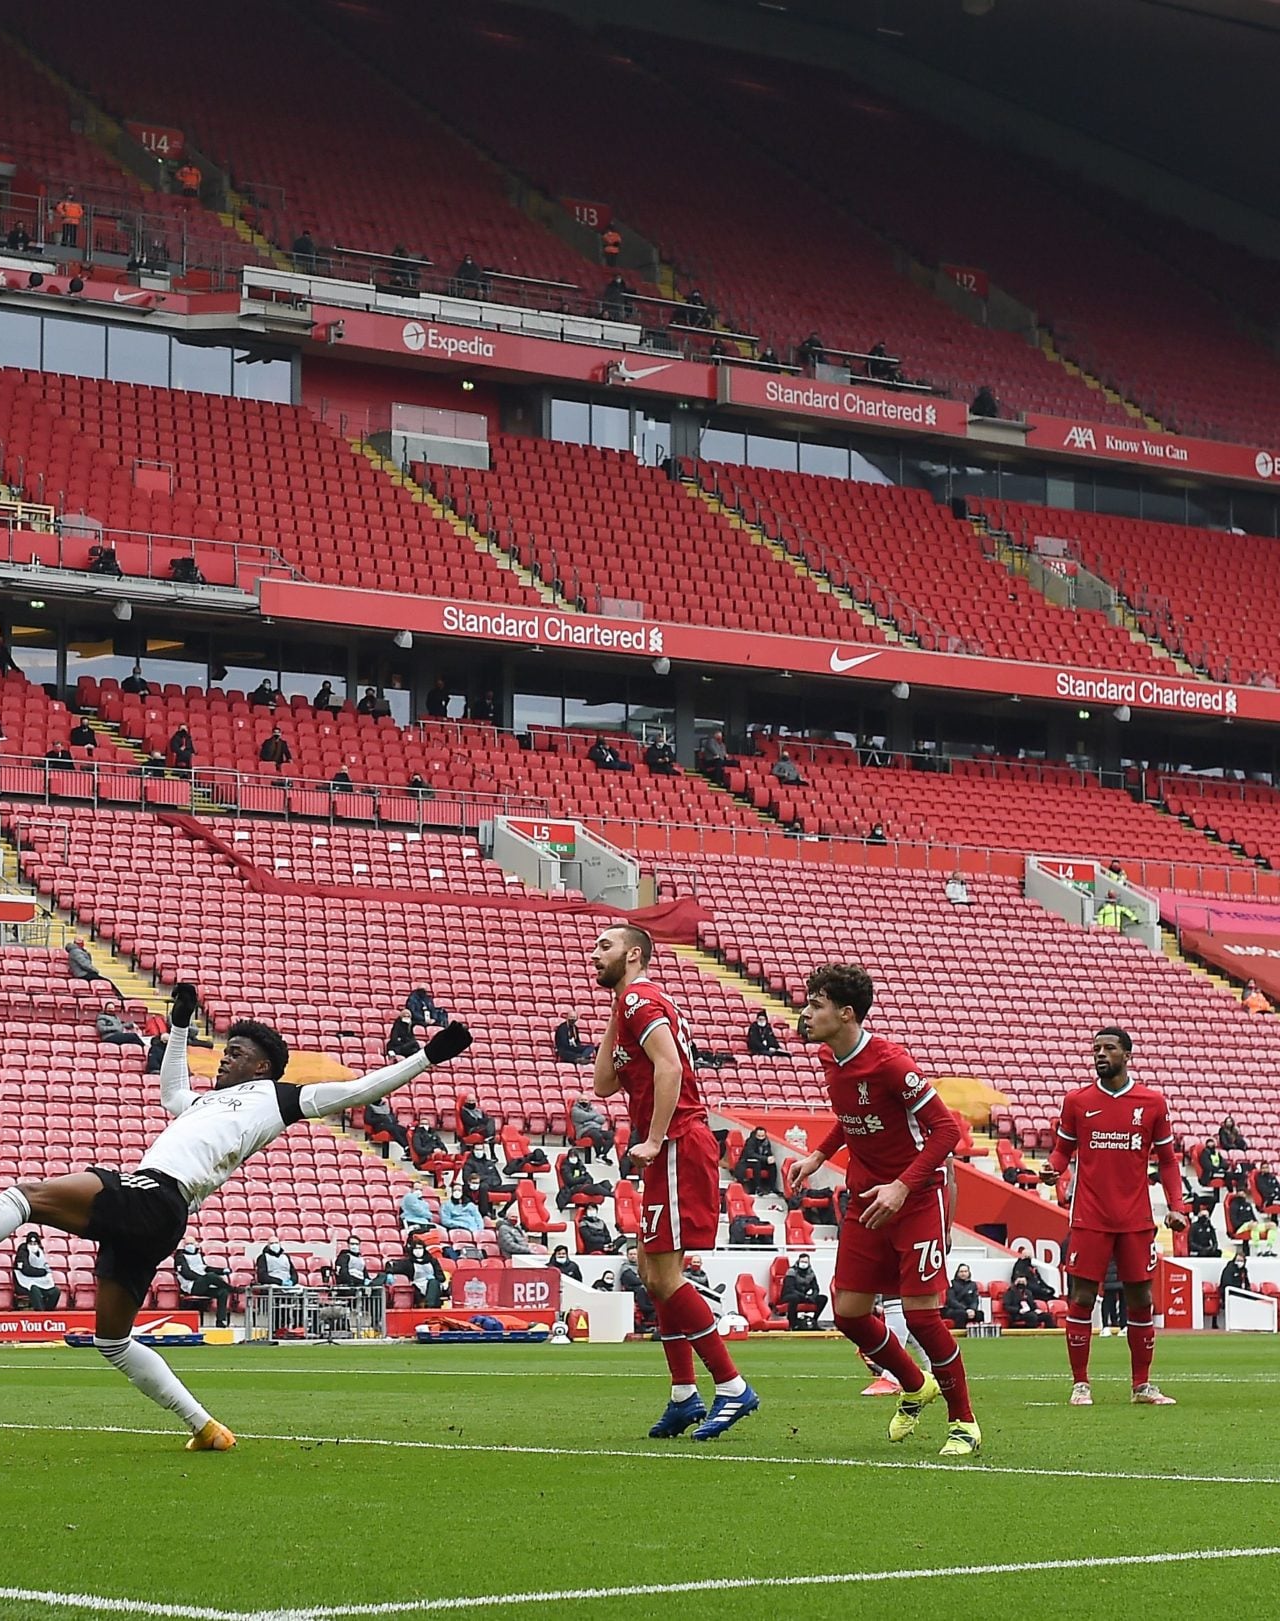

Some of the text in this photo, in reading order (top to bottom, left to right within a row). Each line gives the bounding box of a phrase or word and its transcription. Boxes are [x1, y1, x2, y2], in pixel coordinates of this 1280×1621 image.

[142, 132, 170, 153] U4
[428, 328, 493, 357] Expedia
[766, 381, 923, 423] Standard Chartered
[1063, 426, 1096, 450] AXA
[1105, 435, 1188, 460] Know You Can
[442, 605, 645, 650] Standard Chartered
[1056, 673, 1222, 711] Standard Chartered
[533, 825, 550, 840] L5
[1059, 864, 1074, 879] L4
[1089, 1141, 1129, 1150] Chartered
[1091, 1131, 1130, 1141] Standard
[913, 1239, 943, 1273] 76
[513, 1282, 550, 1302] RED
[20, 1320, 42, 1332] You
[43, 1320, 66, 1332] Can
